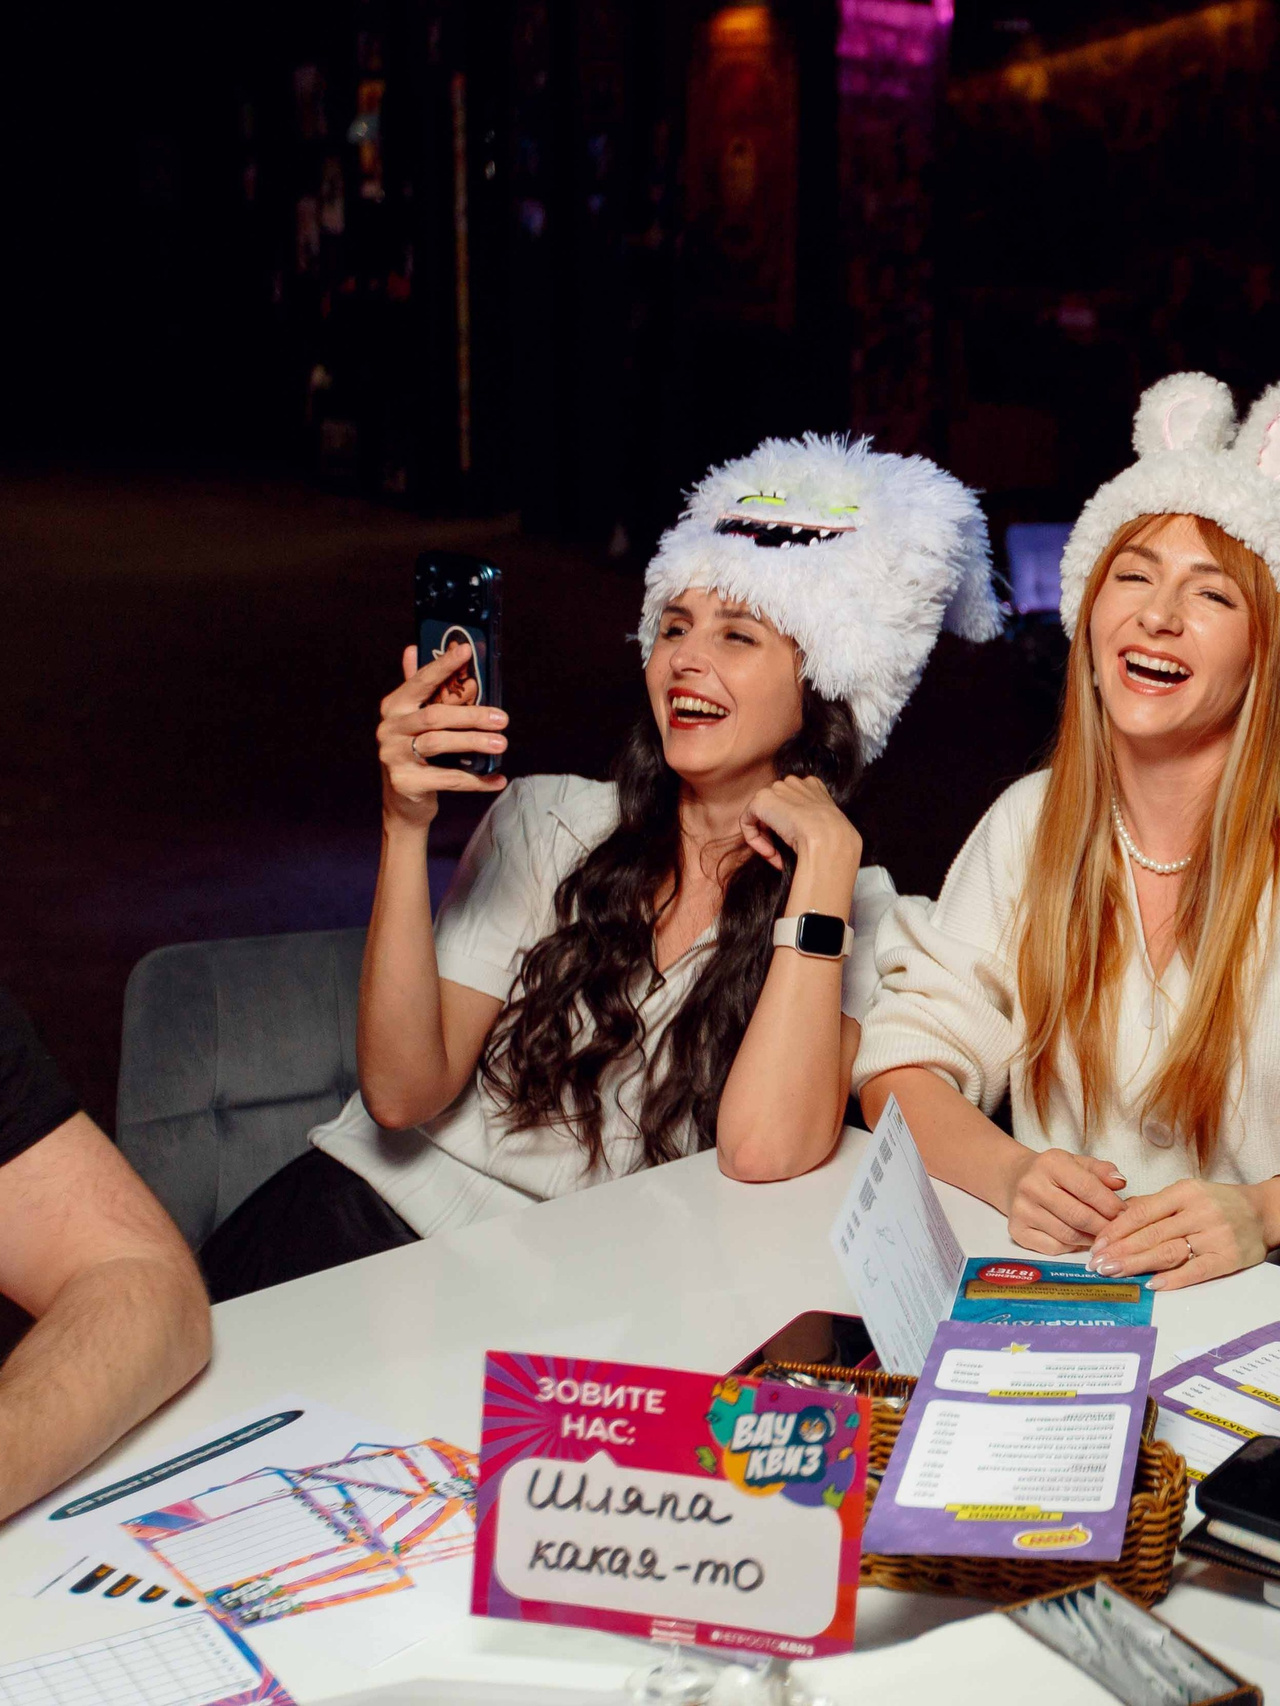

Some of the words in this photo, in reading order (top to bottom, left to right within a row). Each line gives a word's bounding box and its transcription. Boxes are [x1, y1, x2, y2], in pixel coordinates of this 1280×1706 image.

[985, 1272, 1033, 1280] ОСОБЕННО
[987, 1266, 1016, 1275] ЛЕТ
[1018, 1269, 1036, 1277] 18
[535, 1376, 667, 1415] ЗОВИТЕ
[561, 1413, 636, 1446] НАС:
[731, 1412, 795, 1450] ВАУ
[1192, 1409, 1256, 1438] ЗАКУСКИ
[744, 1445, 822, 1480] КВИЗ
[526, 1467, 734, 1526] Шляпа
[967, 1511, 1052, 1520] НАСТОЙКИ
[527, 1539, 766, 1593] какая-то
